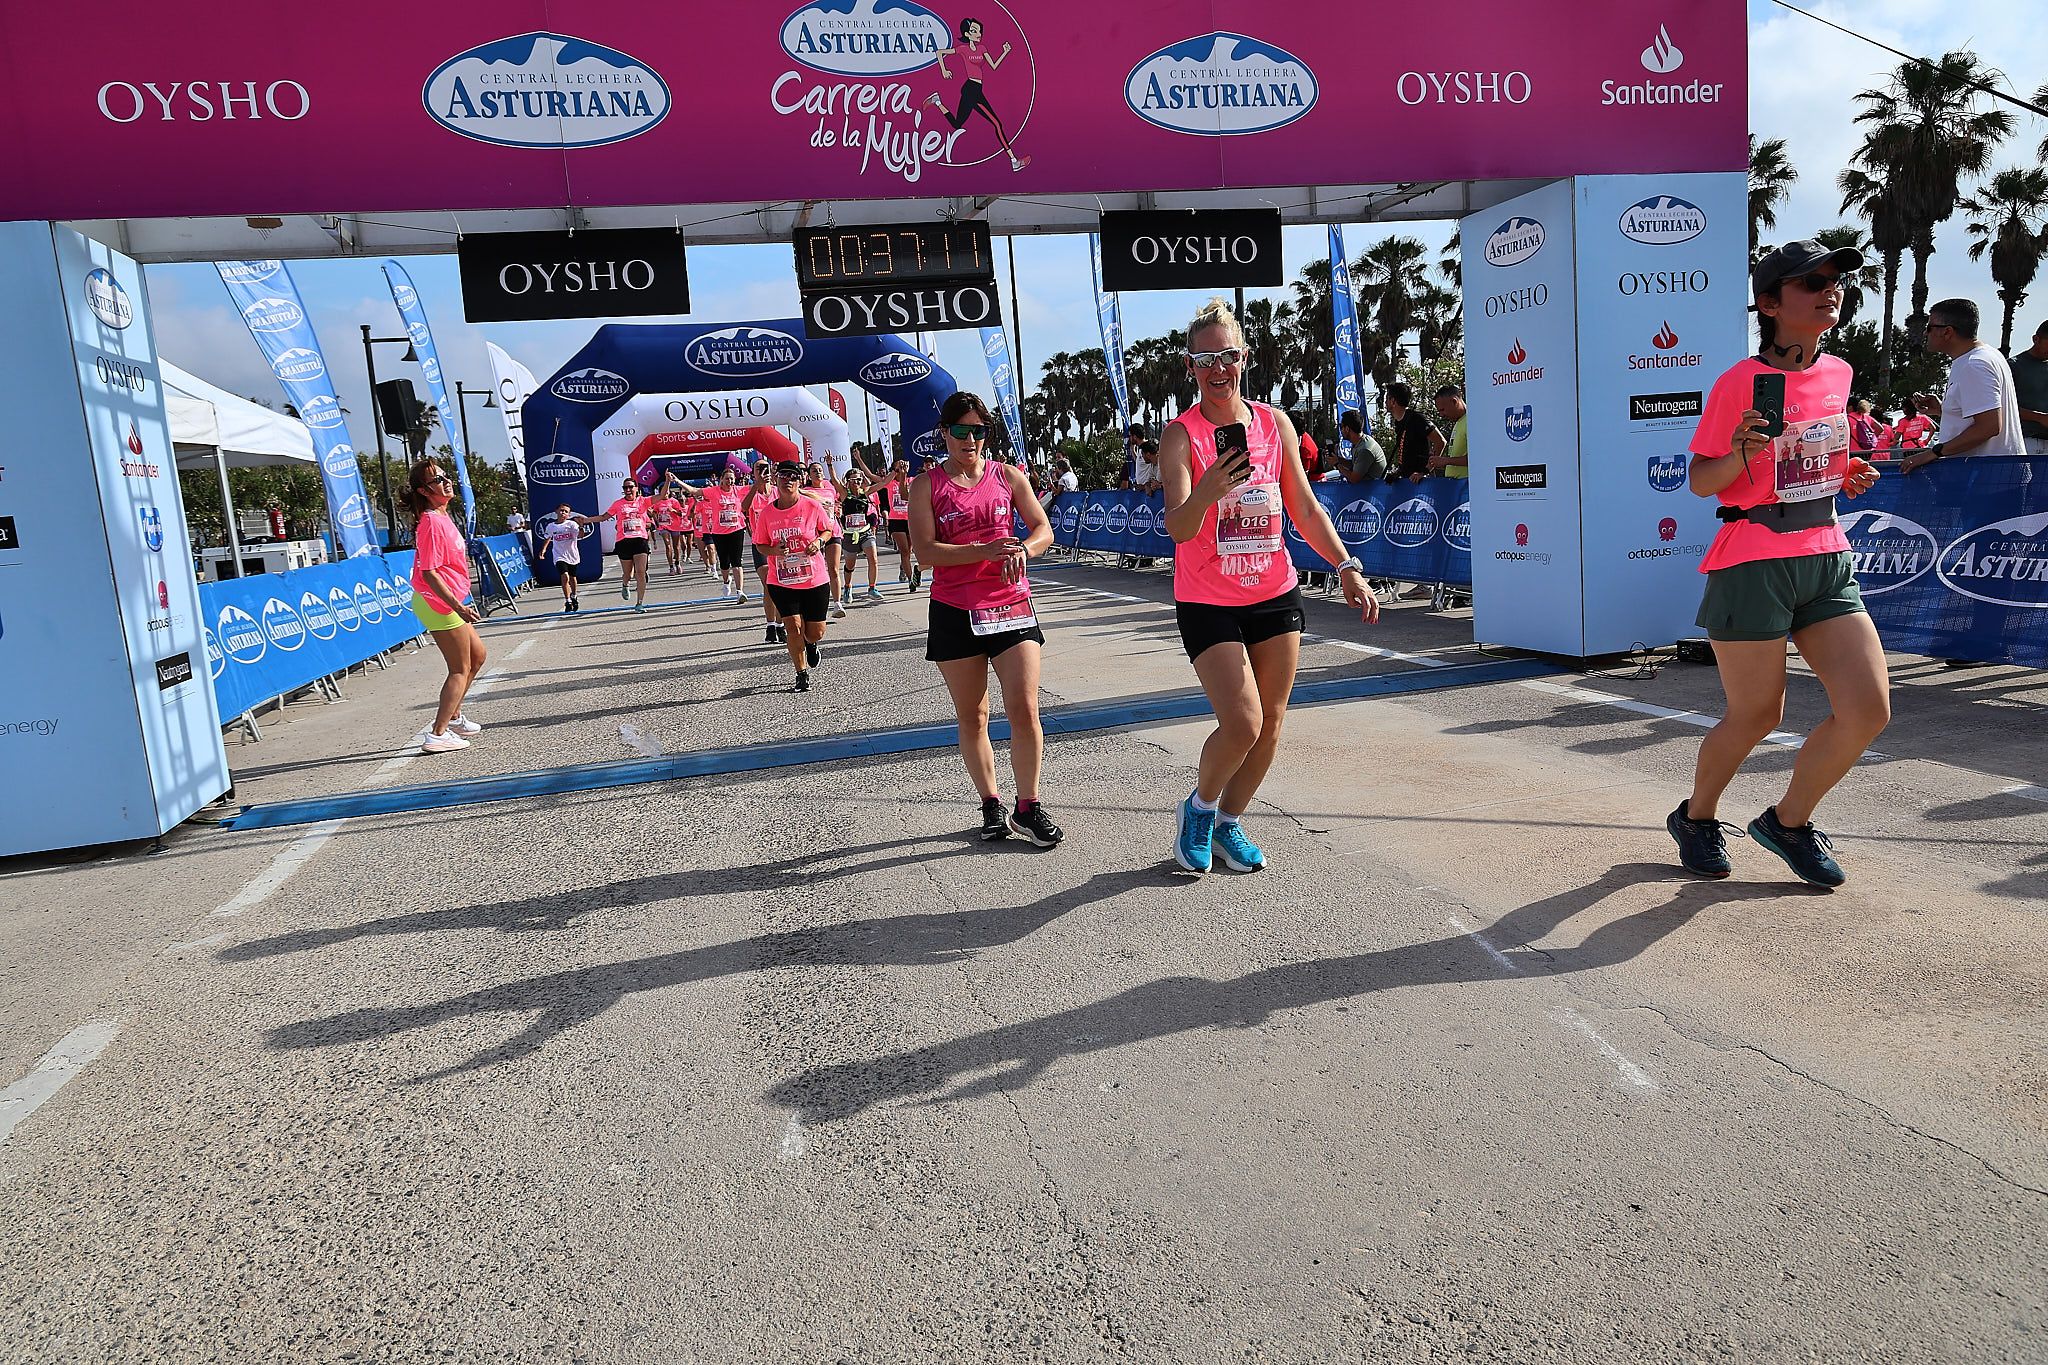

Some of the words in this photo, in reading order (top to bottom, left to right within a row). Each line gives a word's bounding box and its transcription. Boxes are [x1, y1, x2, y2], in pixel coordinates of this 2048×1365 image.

[819, 20, 873, 28] CENTRAL
[878, 20, 933, 28] LECHERA
[795, 22, 938, 54] ASTURIANA
[480, 73, 557, 84] CENTRAL
[566, 73, 643, 84] LECHERA
[1170, 69, 1231, 78] CENTRAL
[1237, 68, 1297, 77] LECHERA
[445, 76, 654, 118] ASTURIANA
[770, 71, 913, 115] Carrera
[1142, 72, 1304, 109] ASTURIANA
[1397, 70, 1532, 104] OYSHO
[1601, 79, 1723, 106] Santander
[97, 80, 310, 123] OYSHO
[810, 118, 837, 148] de
[843, 116, 861, 147] la
[860, 110, 967, 182] Mujer
[1625, 214, 1700, 233] ASTURIANA
[809, 229, 979, 277] 00:37:11
[1132, 235, 1258, 264] OYSHO
[1489, 233, 1541, 260] ASTURIANA
[500, 259, 655, 295] OYSHO
[1618, 269, 1709, 296] OYSHO
[813, 287, 990, 333] OYSHO
[1485, 283, 1548, 318] OYSHO
[752, 339, 790, 347] LECHERA
[694, 344, 796, 366] ASTURIANA
[1628, 353, 1703, 370] Santander
[96, 355, 145, 392] OYSHO
[866, 364, 928, 380] ASTURIANA
[1492, 366, 1545, 386] Santander
[556, 381, 624, 394] ASTURIANA
[664, 396, 769, 422] OYSHO
[799, 414, 830, 422] OYSHO
[1635, 400, 1698, 415] Neutrogena
[602, 428, 636, 437] OYSHO
[656, 433, 687, 444] Sports
[700, 429, 746, 440] Santander
[120, 458, 160, 479] Santander
[820, 454, 848, 463] OSHO
[1803, 454, 1829, 471] 016
[533, 464, 587, 478] ASTURIANA
[1499, 470, 1542, 486] Neutrogena
[1650, 462, 1685, 483] Marlene
[1785, 490, 1812, 499] OYSHO
[1241, 515, 1269, 528] 016
[1336, 516, 1377, 534] ASTURIANA
[1386, 516, 1433, 536] ASTURIANA
[1989, 541, 2046, 551] CENTRA
[1851, 552, 1919, 574] RIANA
[1946, 542, 2048, 582] ASTUR
